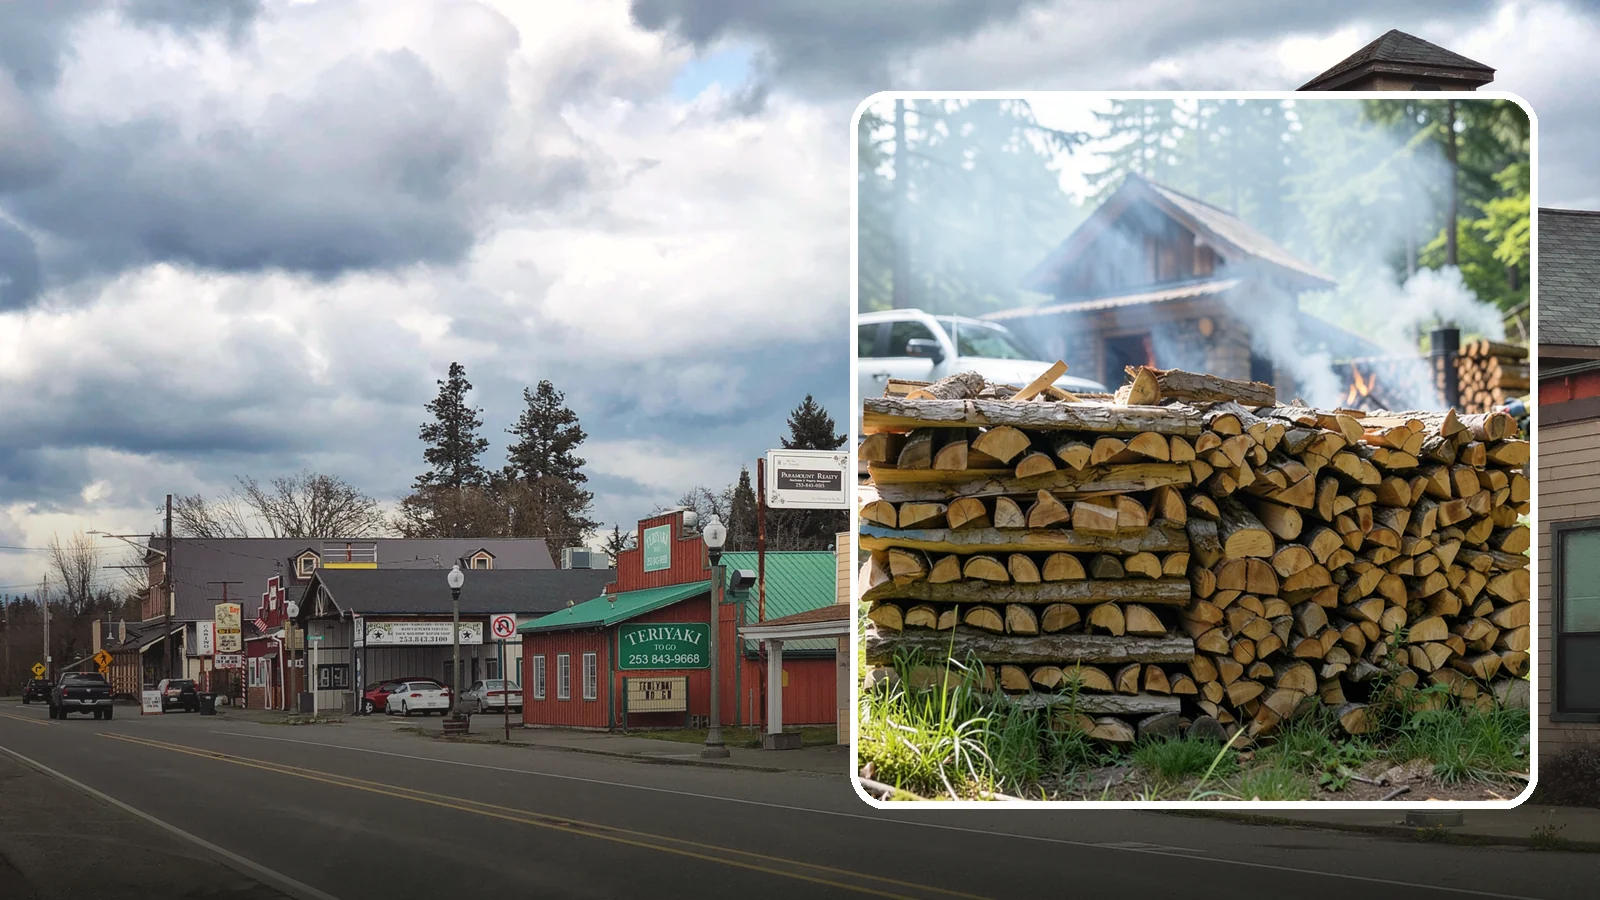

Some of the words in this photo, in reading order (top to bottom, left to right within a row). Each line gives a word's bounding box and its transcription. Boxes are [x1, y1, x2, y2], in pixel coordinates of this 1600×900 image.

[625, 628, 702, 645] TERIYAKI
[629, 654, 648, 664] 253
[652, 654, 700, 664] 843-9668
[639, 681, 673, 691] TERIYAKI
